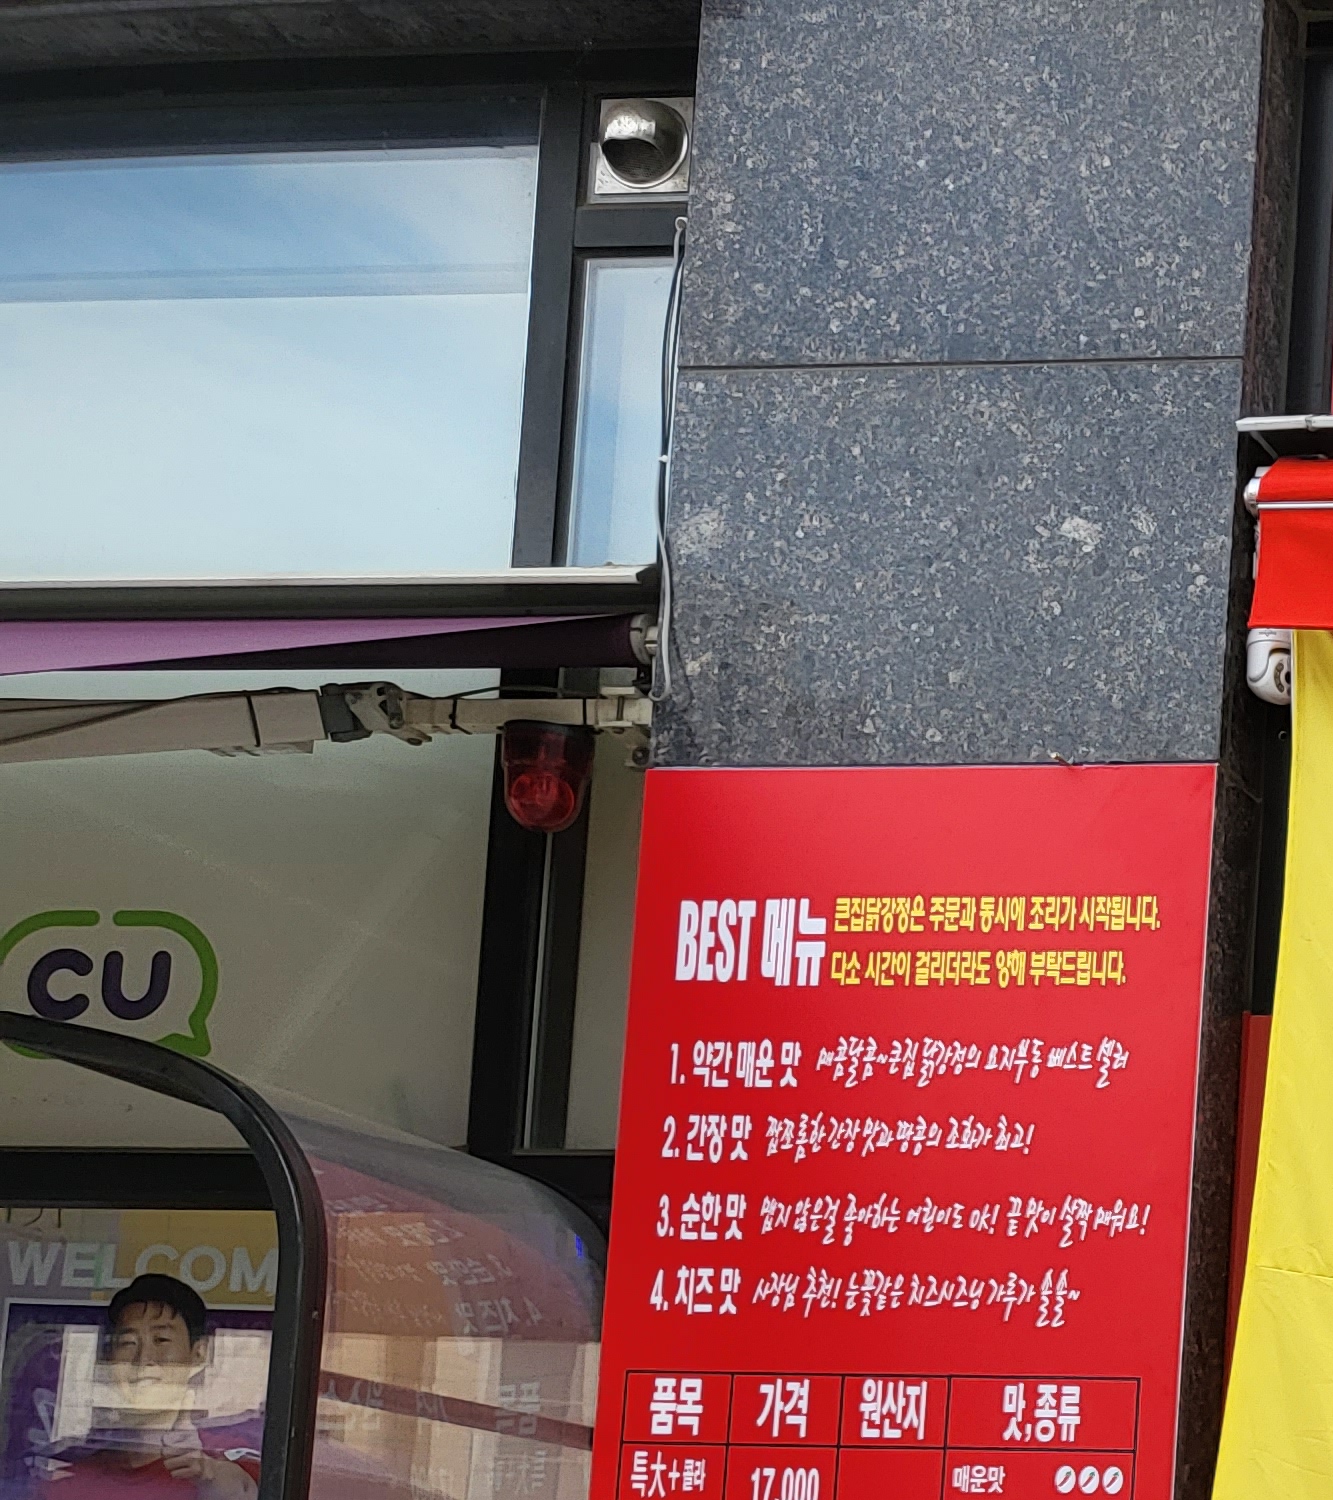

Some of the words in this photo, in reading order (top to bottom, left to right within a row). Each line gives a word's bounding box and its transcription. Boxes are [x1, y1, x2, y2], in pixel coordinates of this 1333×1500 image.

[834, 897, 924, 932] 큰집닭강정은
[929, 897, 976, 932] 주문과
[979, 896, 1024, 932] 동시에
[1028, 896, 1076, 931] 조리가
[1079, 896, 1161, 931] 시작됩니다.
[675, 900, 756, 982] BEST
[760, 899, 827, 987] 메뉴
[26, 948, 171, 1021] CU
[831, 952, 860, 986] 다소
[865, 952, 910, 986] 시간이
[915, 952, 990, 986] 걸리더라도
[996, 951, 1025, 988] 양해
[1029, 952, 1126, 985] 부탁드립니다.
[670, 1043, 685, 1085] 1.
[692, 1040, 731, 1087] 약간
[736, 1040, 774, 1087] 매운
[779, 1041, 801, 1087] 맛
[662, 1116, 680, 1158] 2.
[687, 1115, 726, 1162] 간장
[731, 1116, 752, 1161] 맛
[656, 1194, 673, 1237] 3.
[680, 1193, 721, 1241] 순한
[725, 1194, 746, 1240] 맛
[649, 1270, 668, 1310] 4.
[674, 1268, 714, 1314] 치즈
[718, 1268, 741, 1314] 맛
[650, 1378, 703, 1436] 품목
[756, 1379, 810, 1438] 가격
[860, 1379, 928, 1440] 원산지
[952, 1465, 1005, 1494] 매운맛
